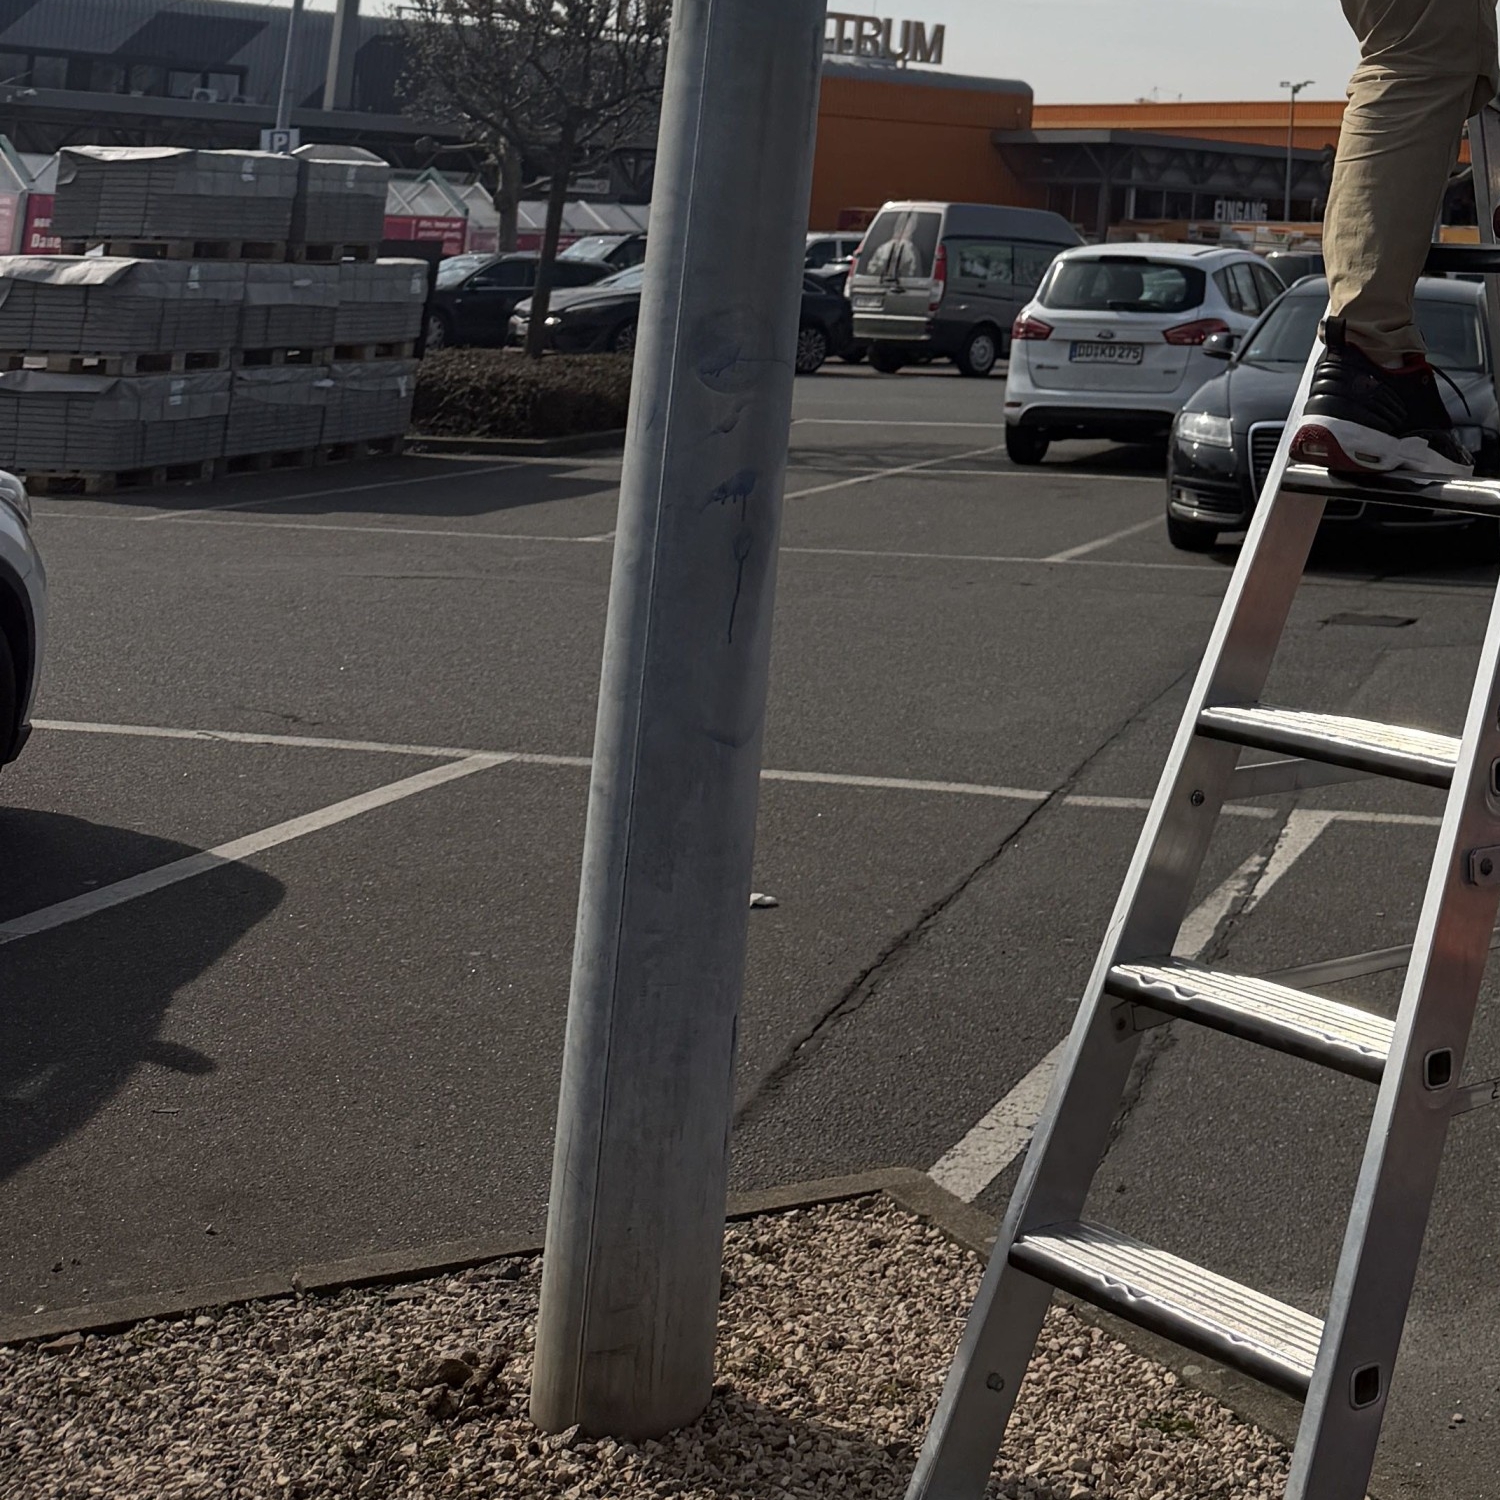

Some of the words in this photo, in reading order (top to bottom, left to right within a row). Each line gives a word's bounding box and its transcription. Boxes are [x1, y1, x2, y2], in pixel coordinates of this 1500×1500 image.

[1214, 200, 1268, 222] EINGANG
[1078, 345, 1093, 358] DD
[1118, 347, 1140, 359] 275
